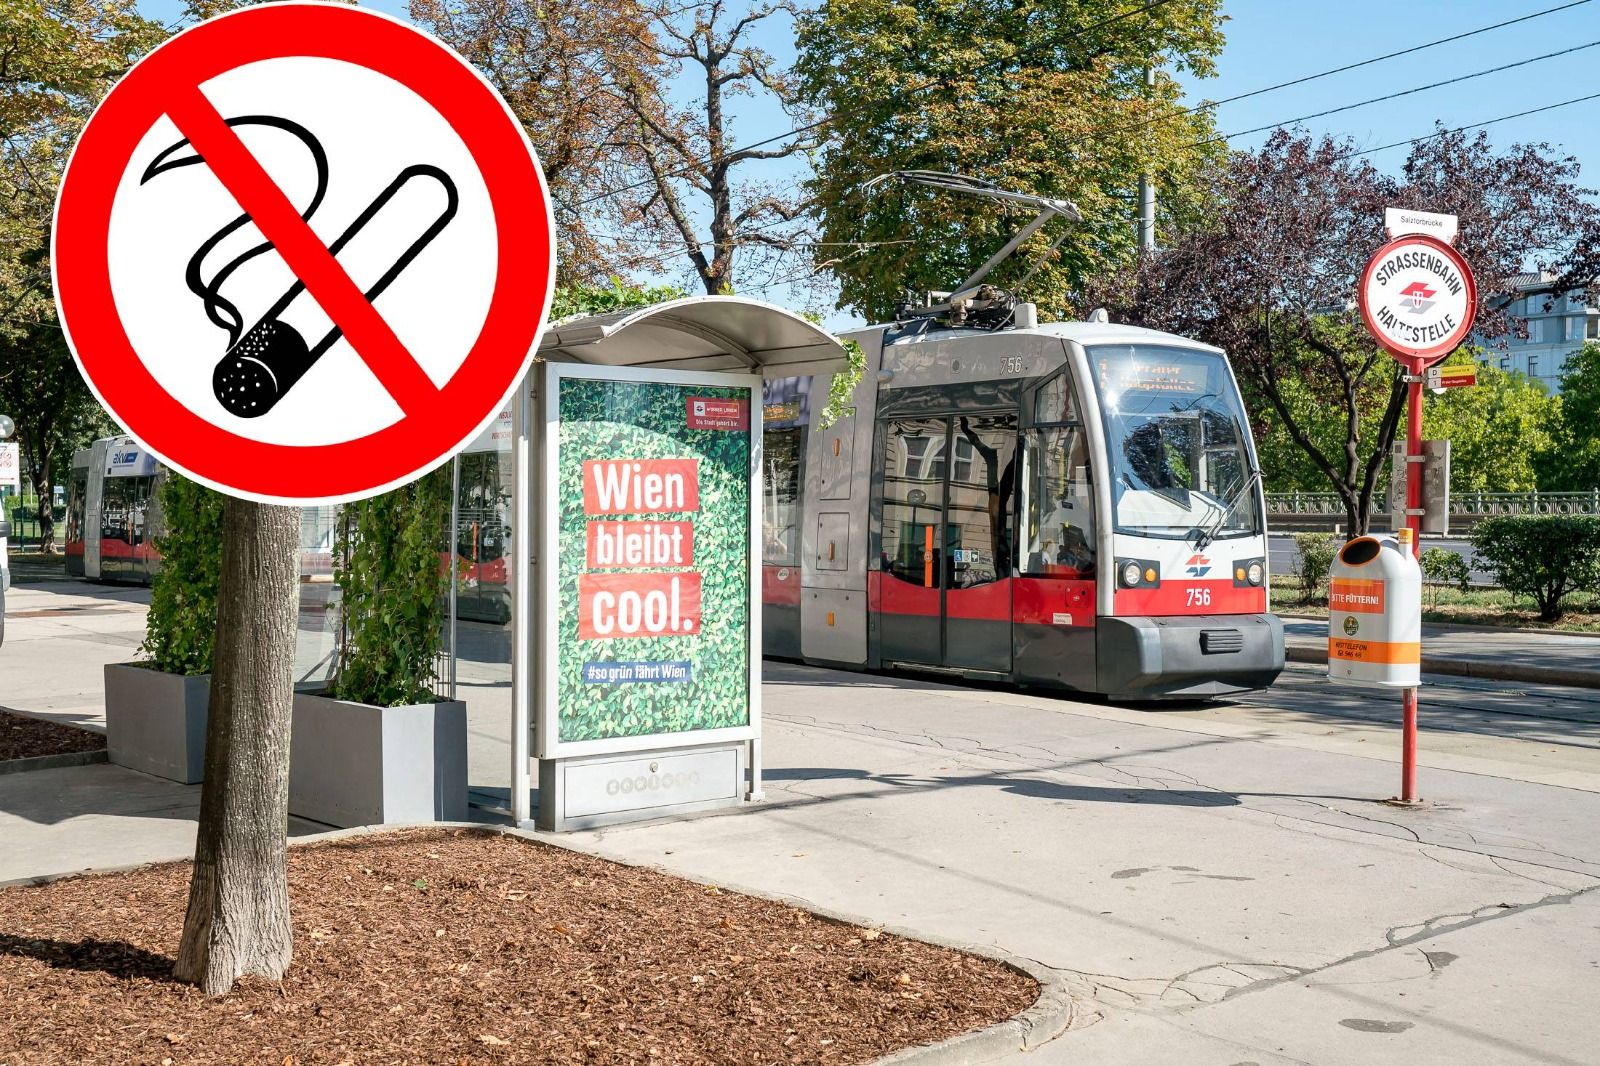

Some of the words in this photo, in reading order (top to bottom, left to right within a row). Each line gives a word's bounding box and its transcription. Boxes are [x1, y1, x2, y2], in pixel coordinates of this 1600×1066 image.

[1400, 216, 1443, 227] Salztorbrücke
[1376, 252, 1462, 296] STRASSENBAHN
[1000, 356, 1022, 376] 756
[592, 462, 685, 511] Wien
[595, 523, 683, 565] bleibt
[592, 576, 694, 635] cool.
[1186, 588, 1211, 607] 756
[1345, 593, 1379, 605] FÜTTERN!
[608, 665, 632, 682] grün
[635, 664, 659, 679] fährt
[661, 664, 686, 679] Wien
